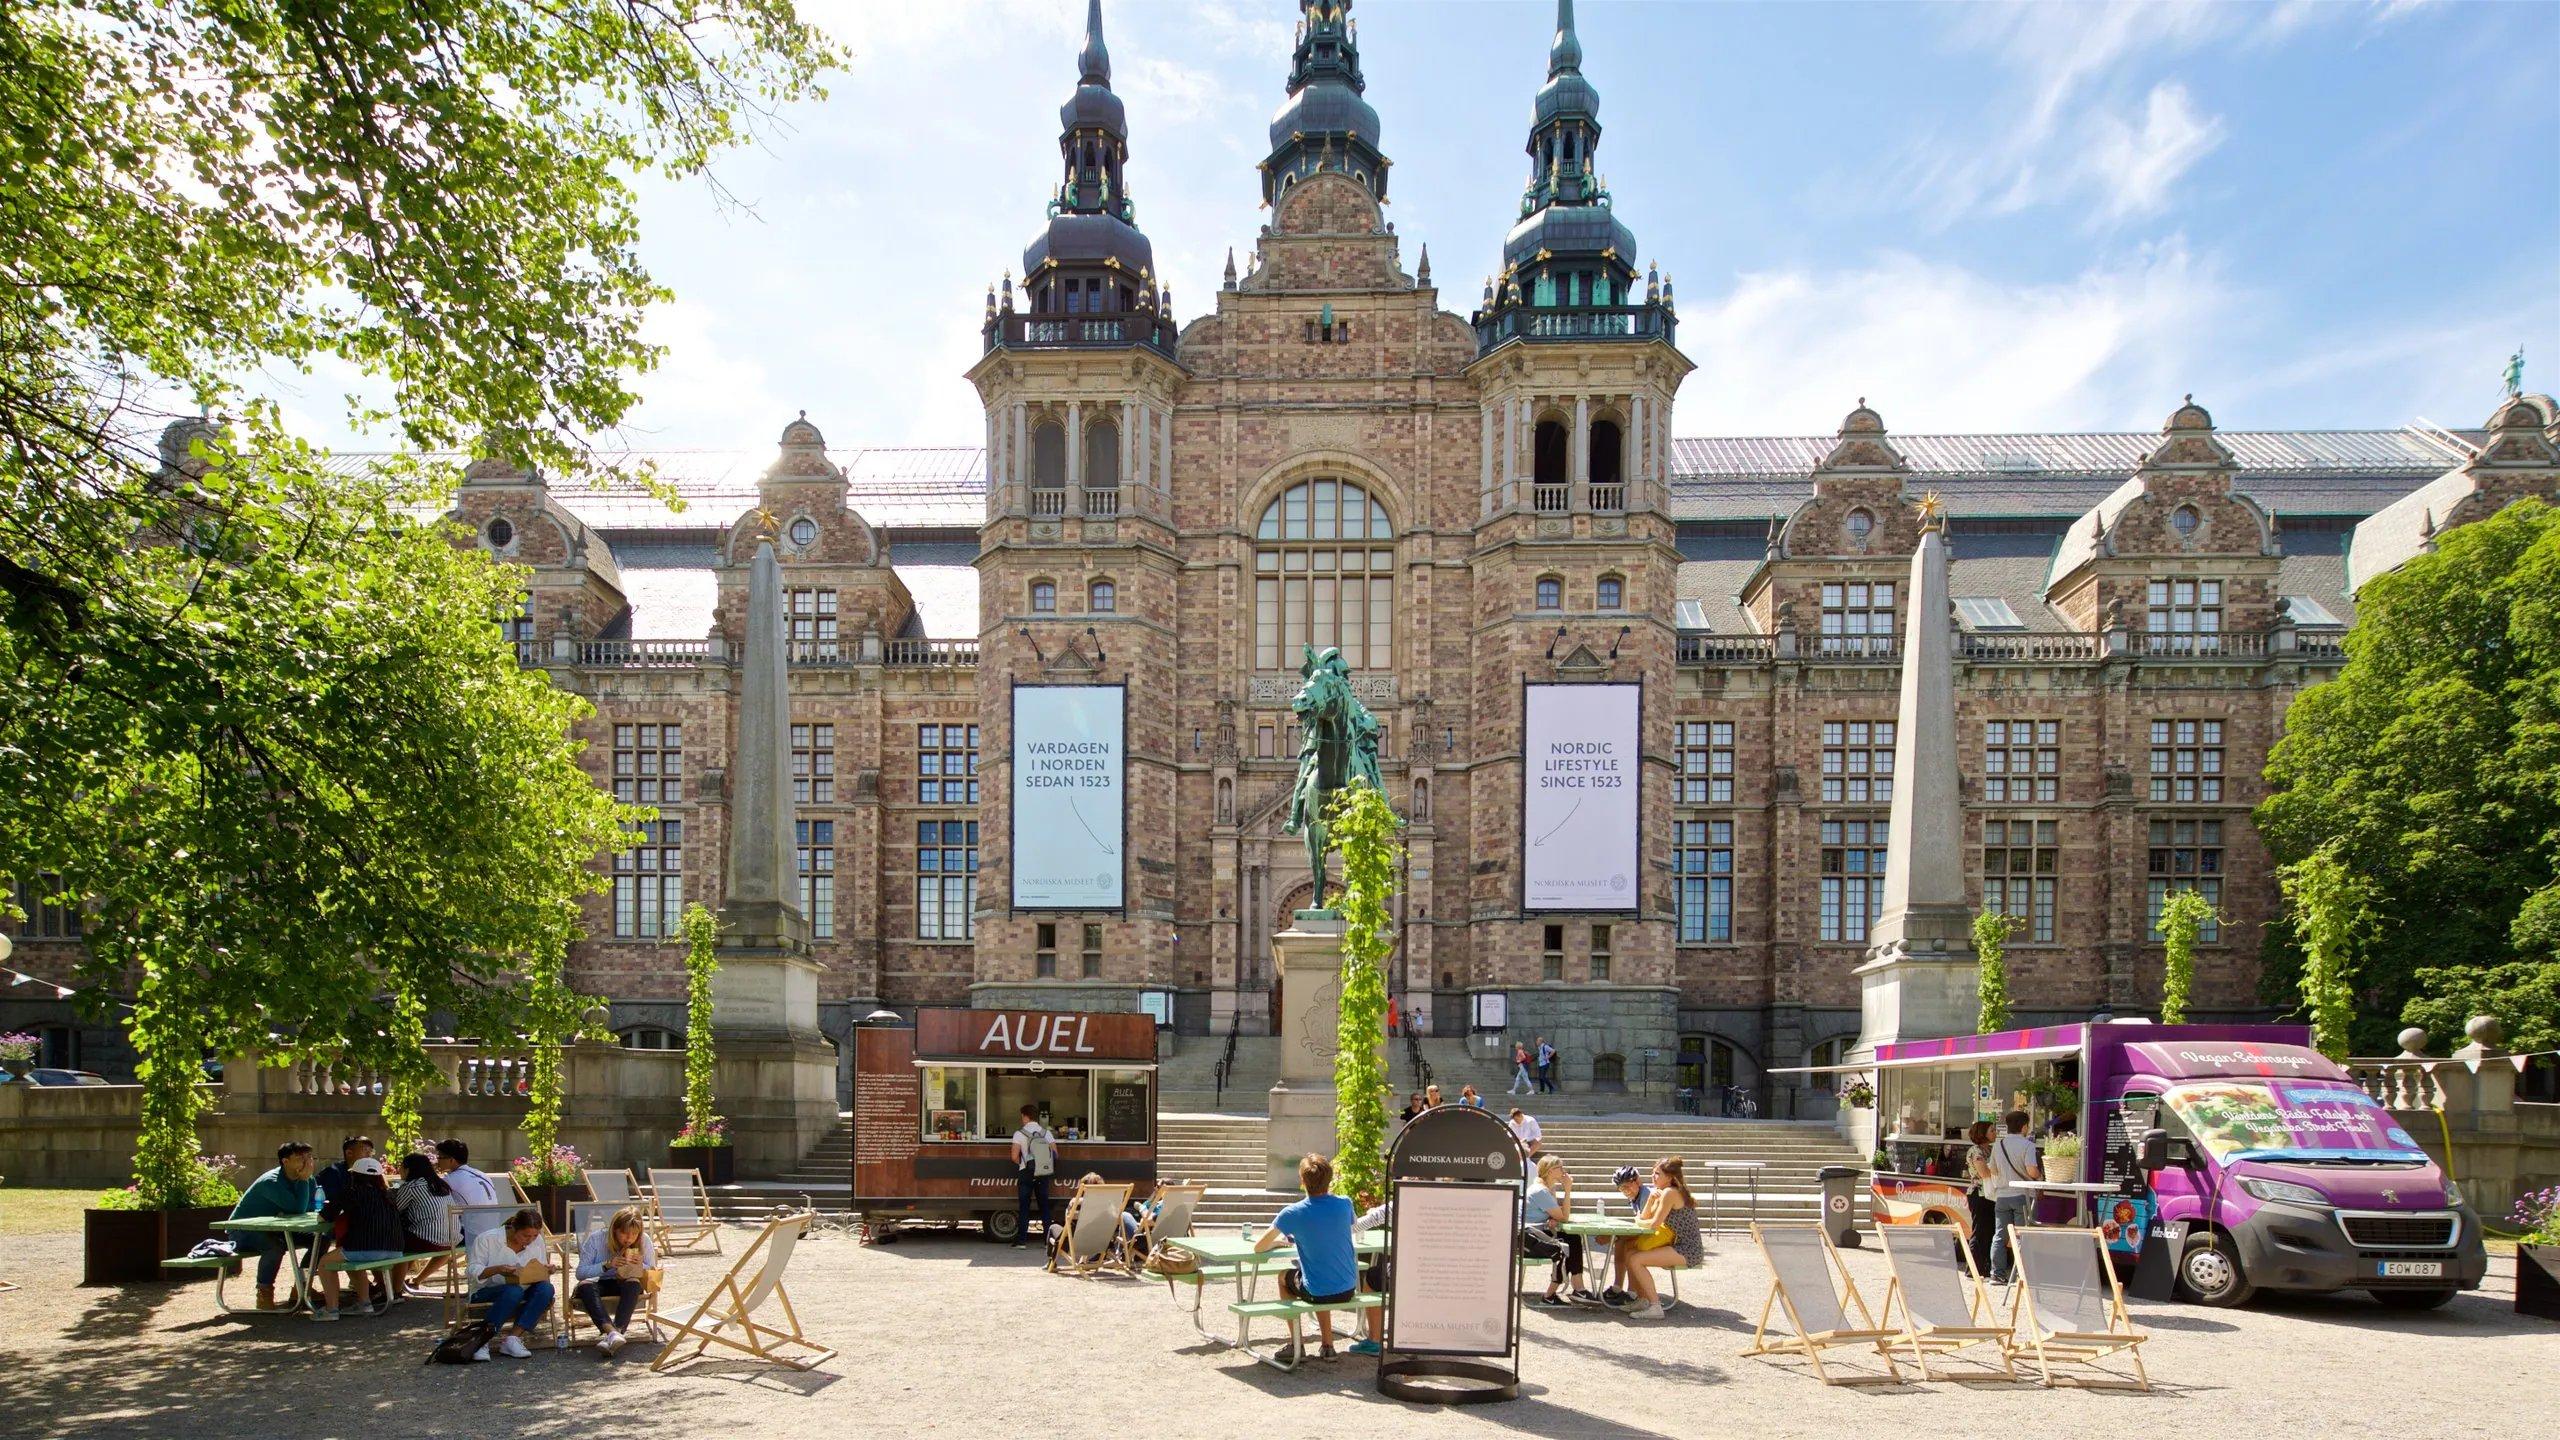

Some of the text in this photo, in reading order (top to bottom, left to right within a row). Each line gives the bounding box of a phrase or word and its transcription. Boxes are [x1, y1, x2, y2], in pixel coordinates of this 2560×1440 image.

[1027, 742, 1109, 754] VARDAGEN
[1551, 742, 1612, 754] NORDIC
[1040, 759, 1105, 771] NORDEN
[1545, 759, 1618, 771] LIFESTYLE
[1026, 776, 1111, 788] SEDAN 1523
[1540, 776, 1622, 788] SINCE 1523
[1021, 878, 1094, 886] NORDISKA MUSEET
[1533, 879, 1608, 887] NORDISKA MUSEET
[979, 1014, 1095, 1052] AUEL
[2180, 1051, 2236, 1067] Vegan
[1409, 1155, 1486, 1164] NORDISKA MUSEET
[2415, 1264, 2437, 1275] 087
